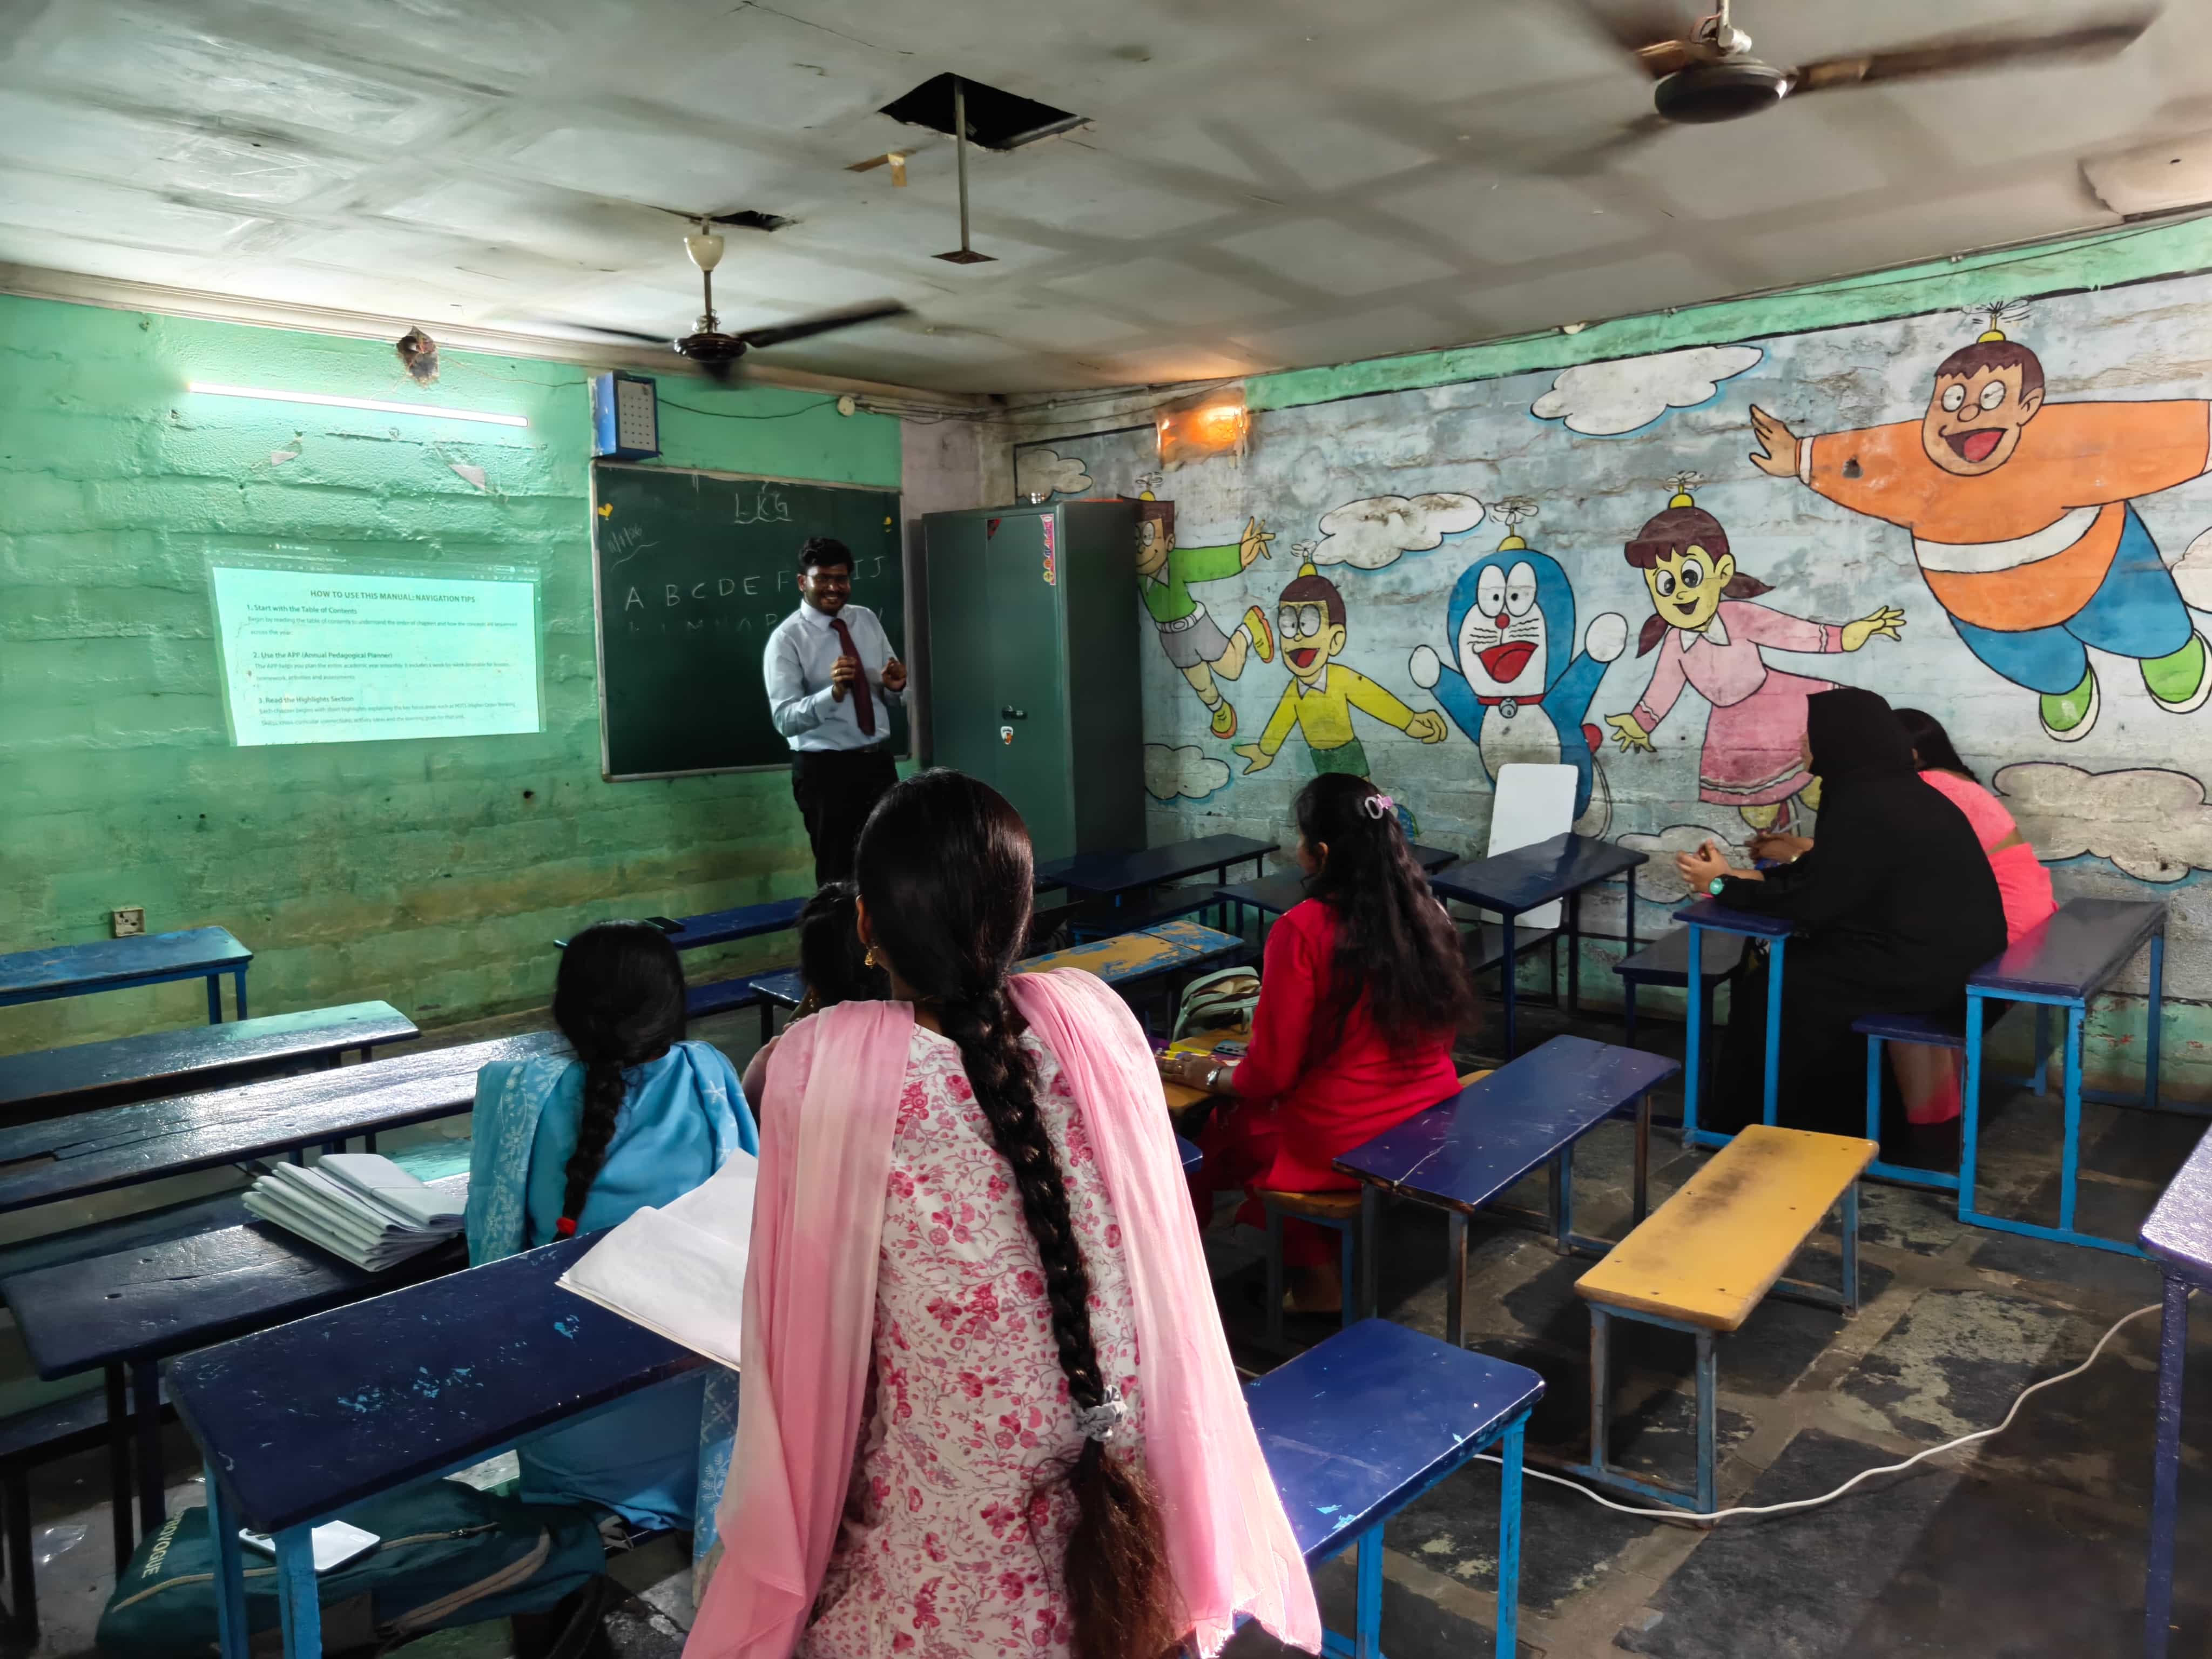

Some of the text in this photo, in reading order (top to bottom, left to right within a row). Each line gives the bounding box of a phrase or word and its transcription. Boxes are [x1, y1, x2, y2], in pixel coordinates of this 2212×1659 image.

[735, 492, 788, 517] LKG
[625, 556, 885, 611] A B C D E F I J
[311, 590, 330, 598] HOW
[416, 594, 460, 602] NAVIGATION
[328, 606, 358, 615] Contents
[328, 651, 366, 659] Pedagogical
[296, 695, 329, 704] Highlights
